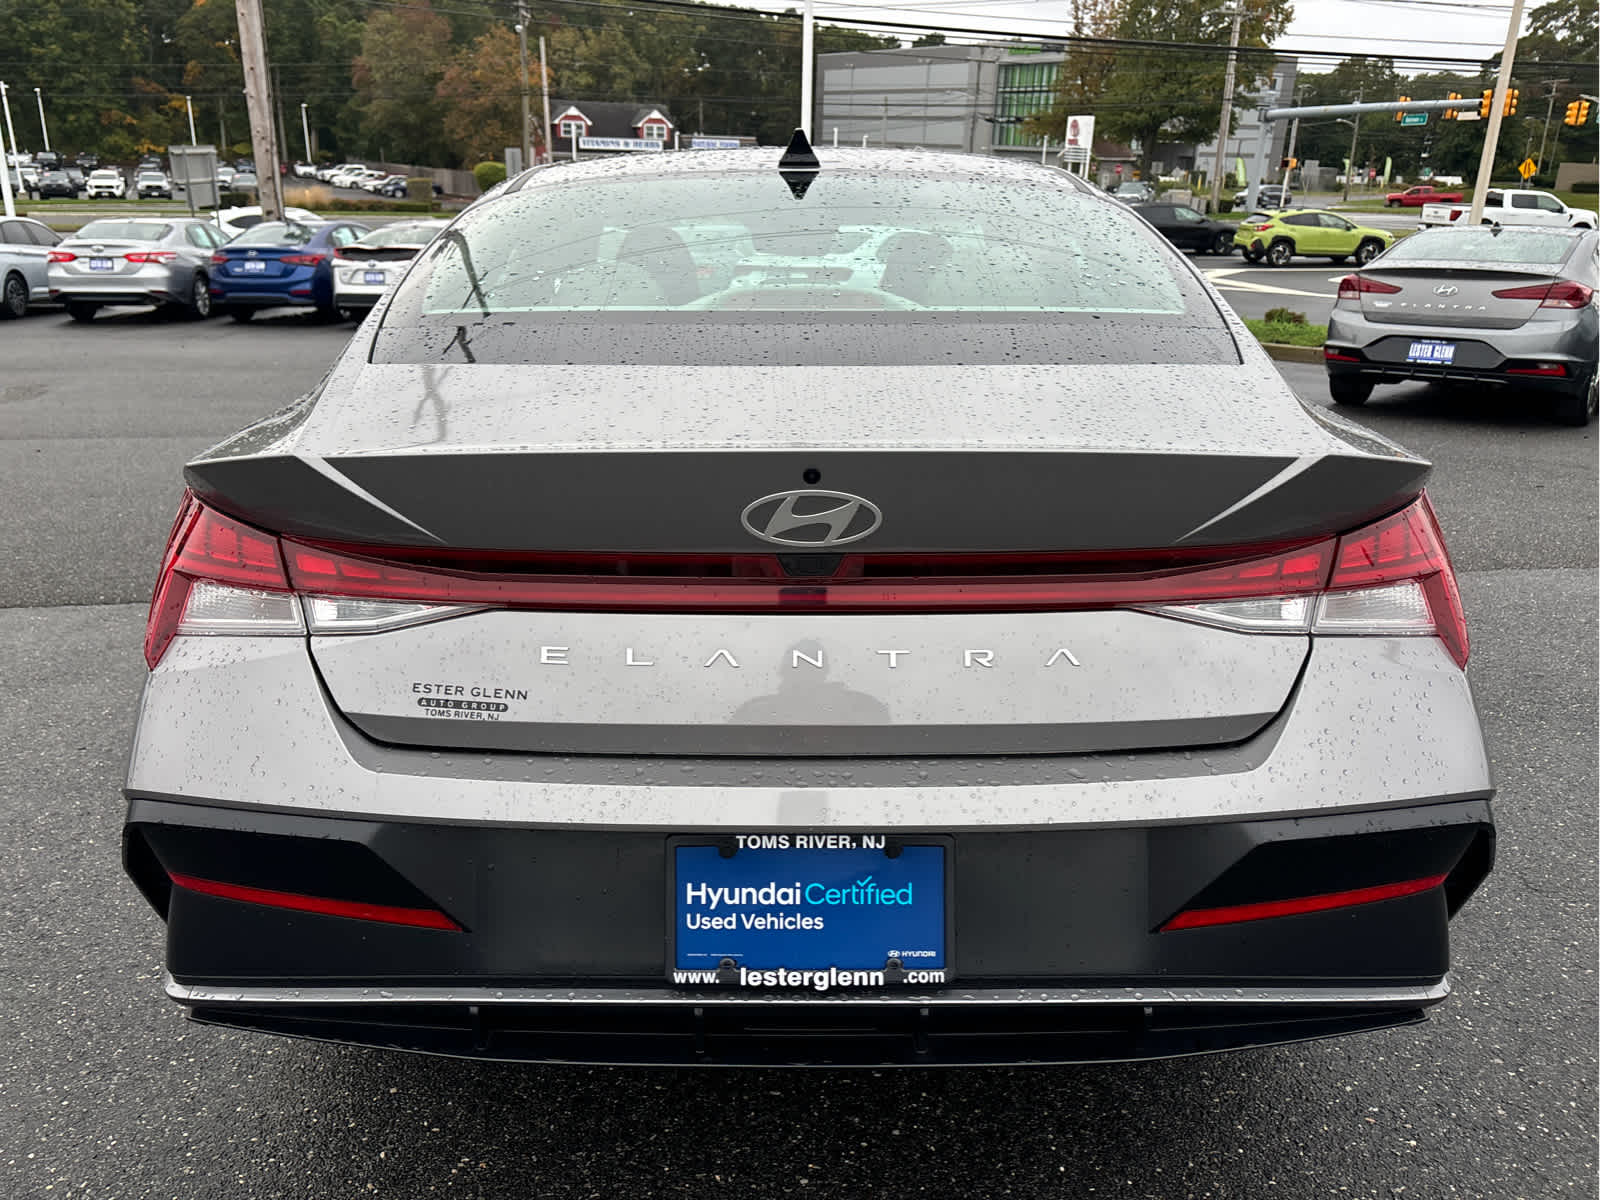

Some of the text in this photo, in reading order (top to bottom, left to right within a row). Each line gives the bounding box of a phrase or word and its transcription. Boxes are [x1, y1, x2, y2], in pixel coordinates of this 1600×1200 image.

[1409, 343, 1455, 359] LESTER GLENN
[539, 646, 1081, 668] ELANTRA
[412, 682, 528, 701] ESTER GLENN
[420, 699, 506, 711] AUTO GROUP
[424, 708, 500, 721] TOMS RIVER, NJ
[736, 835, 886, 850] TOMS RIVER, NJ
[686, 876, 913, 910] Hyundai Certified
[686, 912, 824, 930] Used Vehicles
[901, 950, 937, 958] HYUNDAI
[673, 967, 945, 991] www. lesterglenn .com
